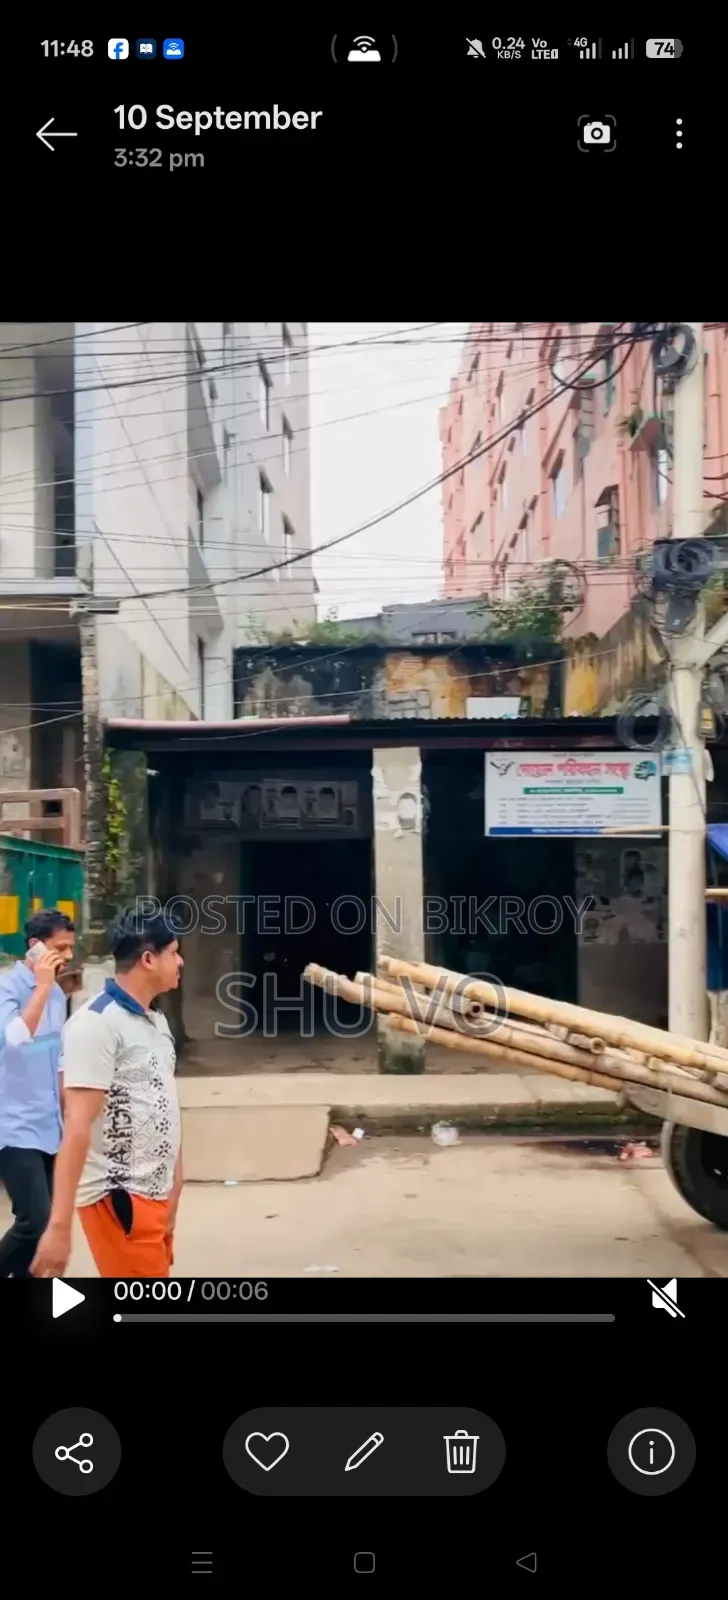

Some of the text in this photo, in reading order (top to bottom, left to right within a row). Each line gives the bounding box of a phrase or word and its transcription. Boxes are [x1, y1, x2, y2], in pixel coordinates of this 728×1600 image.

[41, 40, 93, 57] 11:48
[492, 37, 525, 50] 0.24
[531, 37, 548, 48] Vo
[573, 37, 588, 48] 4G
[653, 42, 675, 56] 74
[497, 50, 521, 60] KB/S
[114, 104, 323, 135] 10 September
[114, 148, 205, 172] 3:32 pm
[114, 1281, 181, 1301] 00:00
[201, 1281, 269, 1301] 00:06
